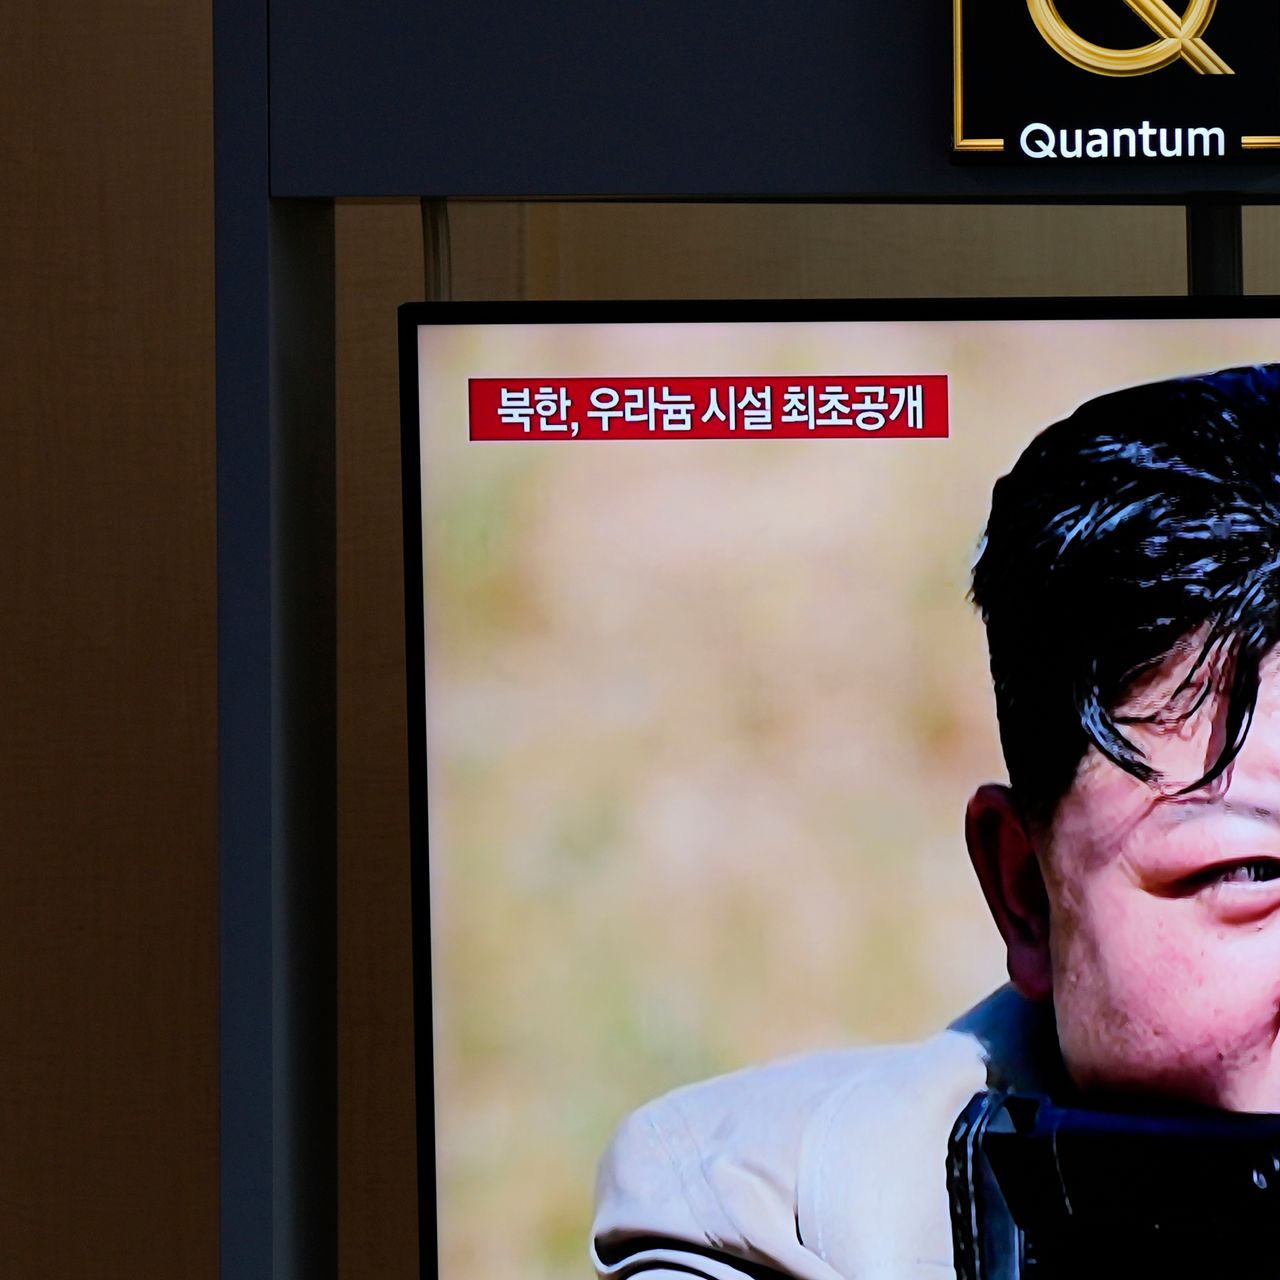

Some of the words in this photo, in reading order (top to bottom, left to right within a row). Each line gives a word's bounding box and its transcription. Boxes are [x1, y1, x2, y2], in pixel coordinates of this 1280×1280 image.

[1019, 120, 1225, 159] Quantum
[497, 387, 580, 438] 북한,
[587, 386, 696, 432] 우라늄
[701, 385, 773, 431] 시설
[781, 384, 924, 431] 최초공개
